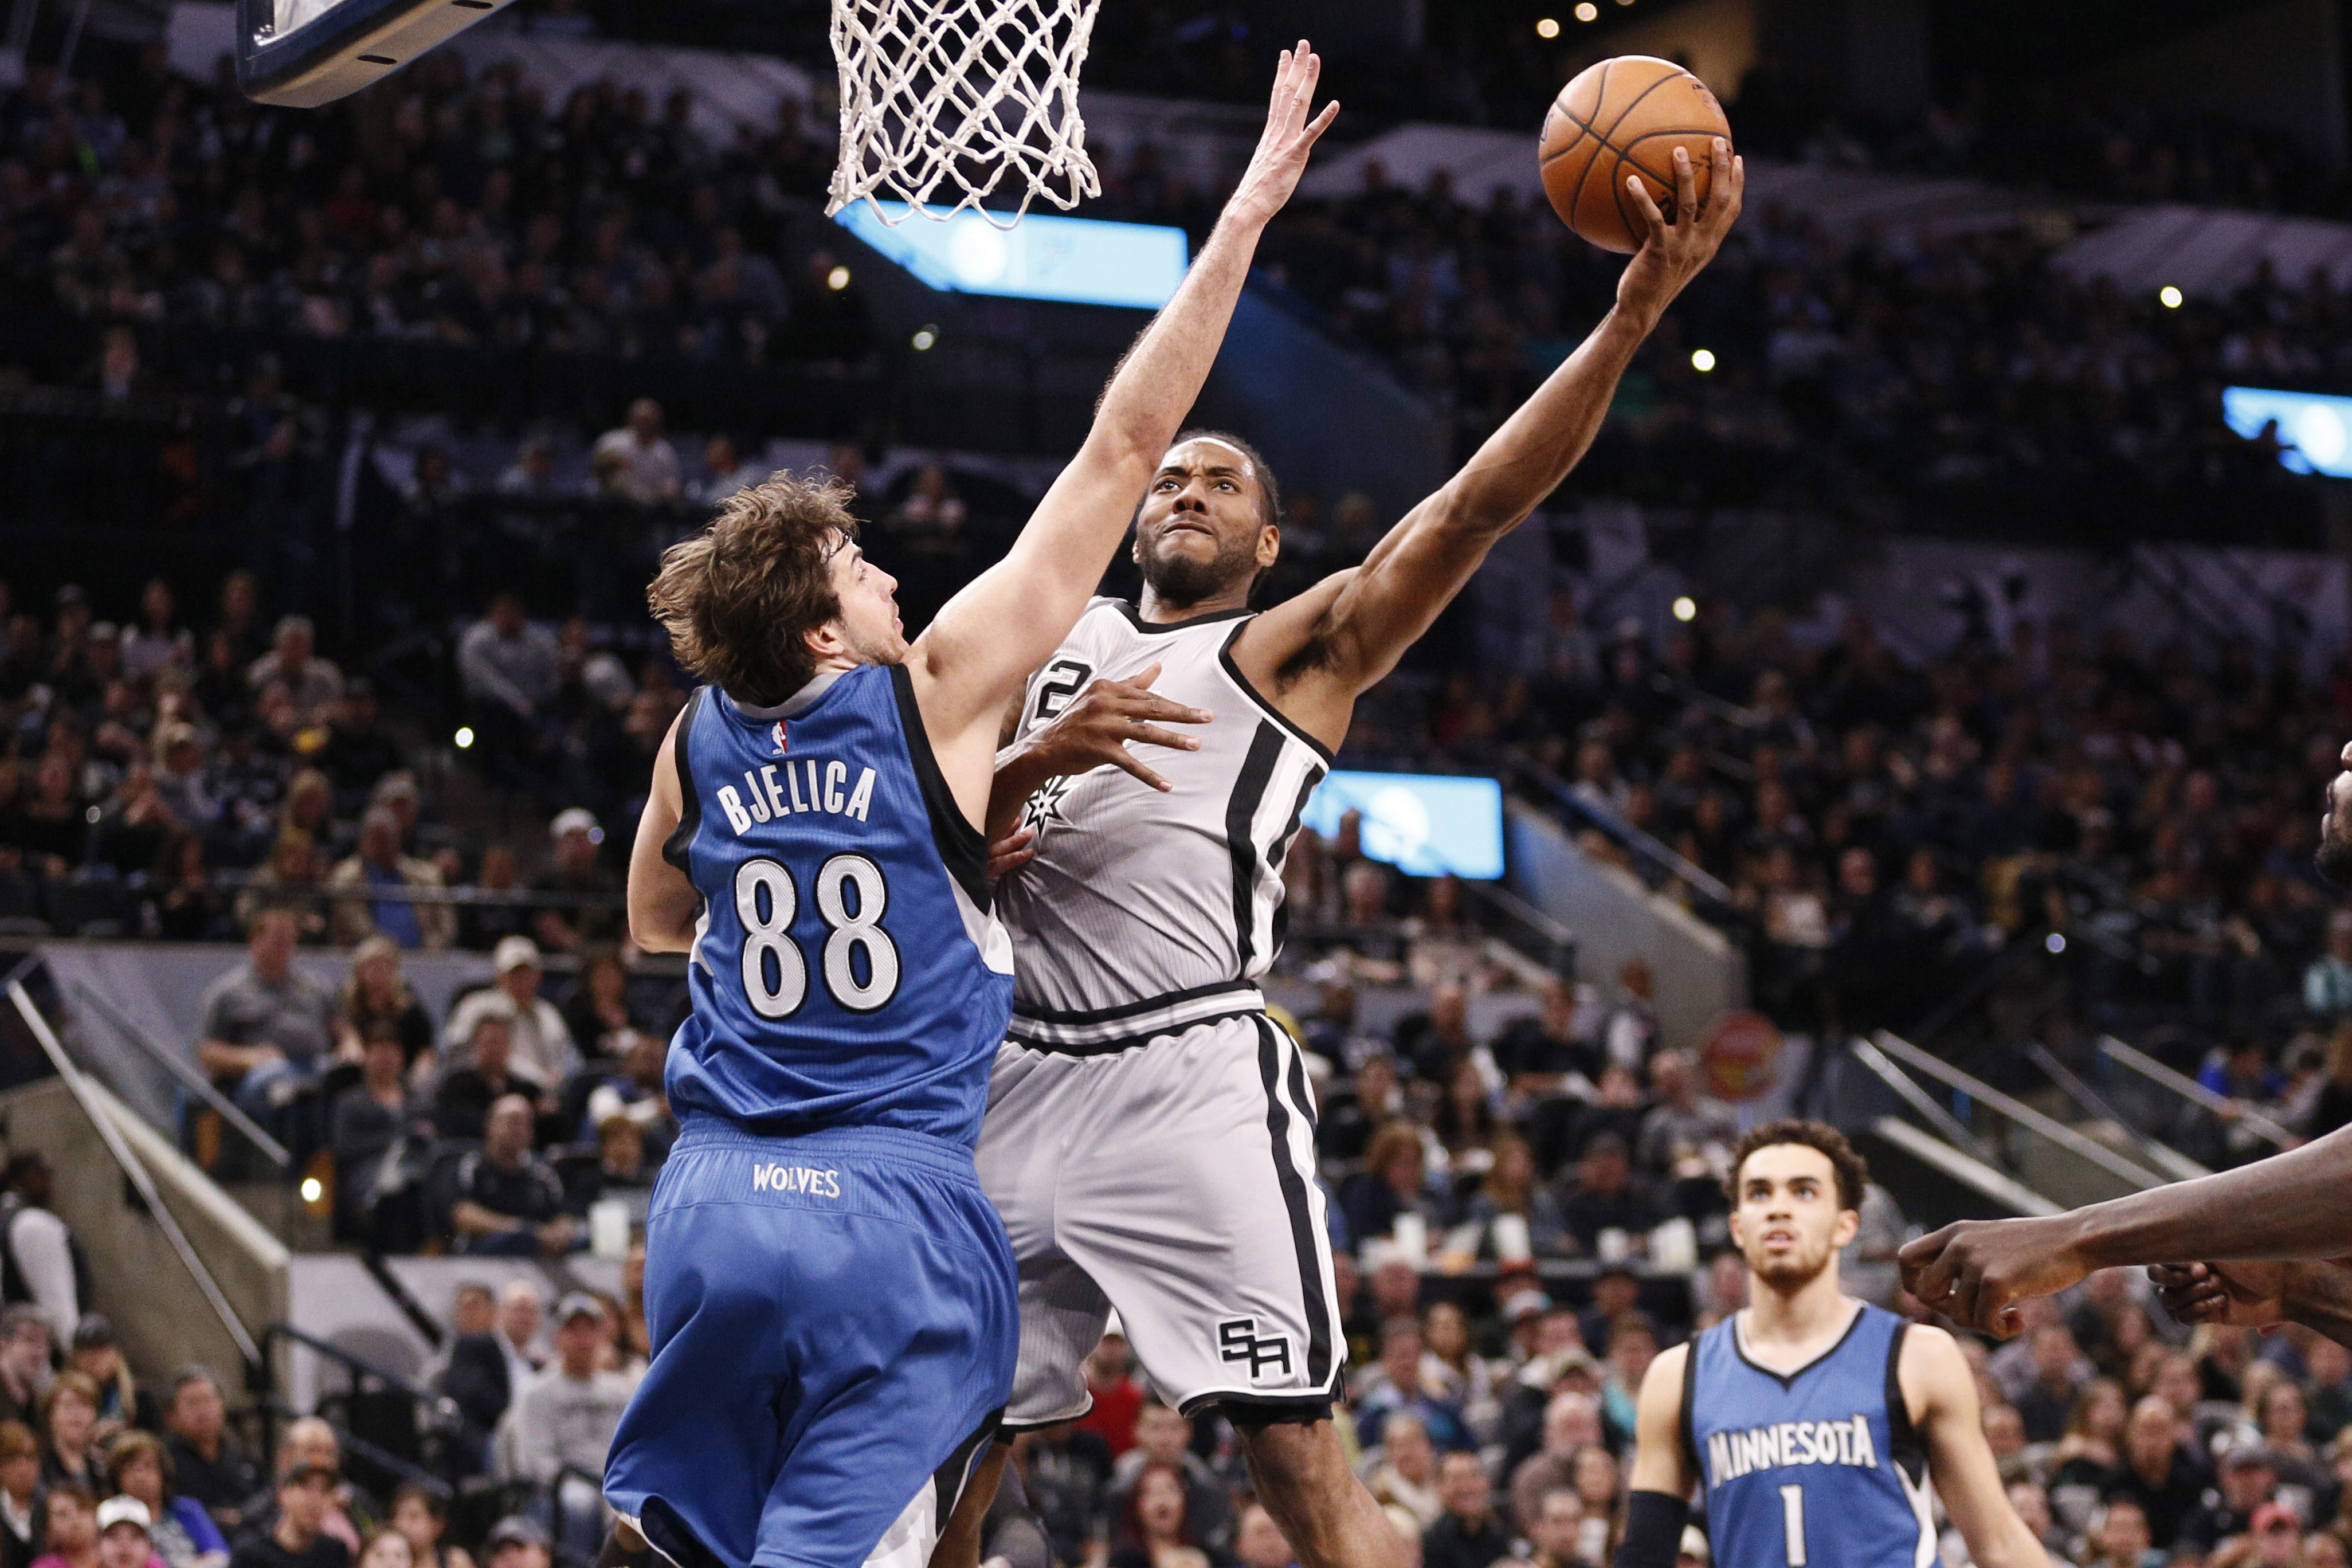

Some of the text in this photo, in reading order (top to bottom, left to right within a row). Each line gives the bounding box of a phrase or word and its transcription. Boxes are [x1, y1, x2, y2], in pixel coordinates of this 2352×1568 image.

[1030, 656, 1097, 726] 2
[717, 759, 876, 836] BJELICA
[735, 853, 900, 1019] 88
[754, 1163, 841, 1198] WOLVES
[1218, 1317, 1293, 1379] SA
[1707, 1414, 1878, 1489] MINNESOTA
[1779, 1484, 1807, 1567] 1
